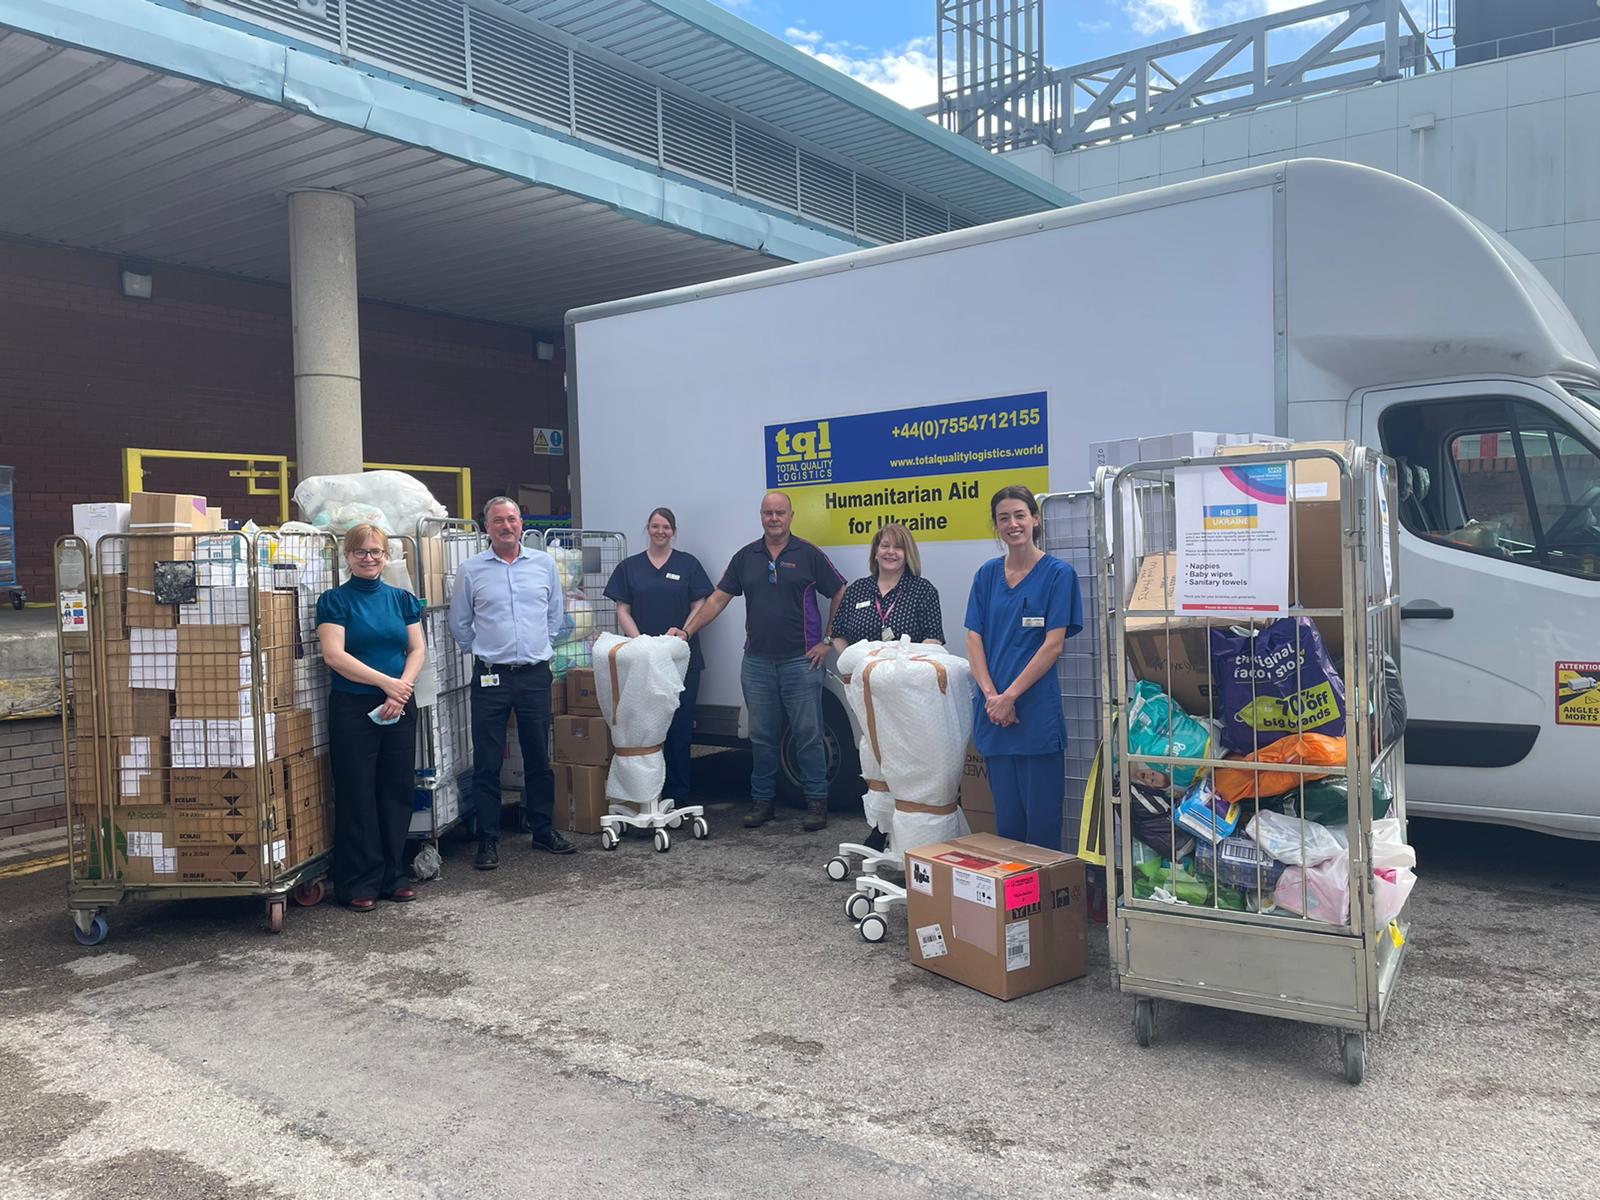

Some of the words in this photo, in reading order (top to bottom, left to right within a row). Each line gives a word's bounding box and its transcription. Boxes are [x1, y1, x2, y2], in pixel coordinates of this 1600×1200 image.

[892, 408, 1040, 440] +44(0)7554712155
[776, 421, 831, 460] tql
[890, 444, 1044, 467] www.totalqualitylogistics.world
[776, 463, 799, 473] TOTAL
[801, 459, 832, 471] QUALITY
[778, 469, 832, 482] LOGISTICS
[825, 486, 942, 509] Humanitarian
[948, 480, 979, 501] Aid
[1220, 508, 1241, 517] HELP
[848, 517, 872, 534] for
[1212, 517, 1248, 526] UKRAINE
[1189, 562, 1220, 570] Nappies
[1189, 570, 1209, 579] Baby
[1211, 571, 1233, 579] wipes
[1189, 578, 1221, 587] Sanitary
[1307, 691, 1328, 710] off
[1563, 706, 1599, 714] ANGLES
[1263, 718, 1286, 729] big
